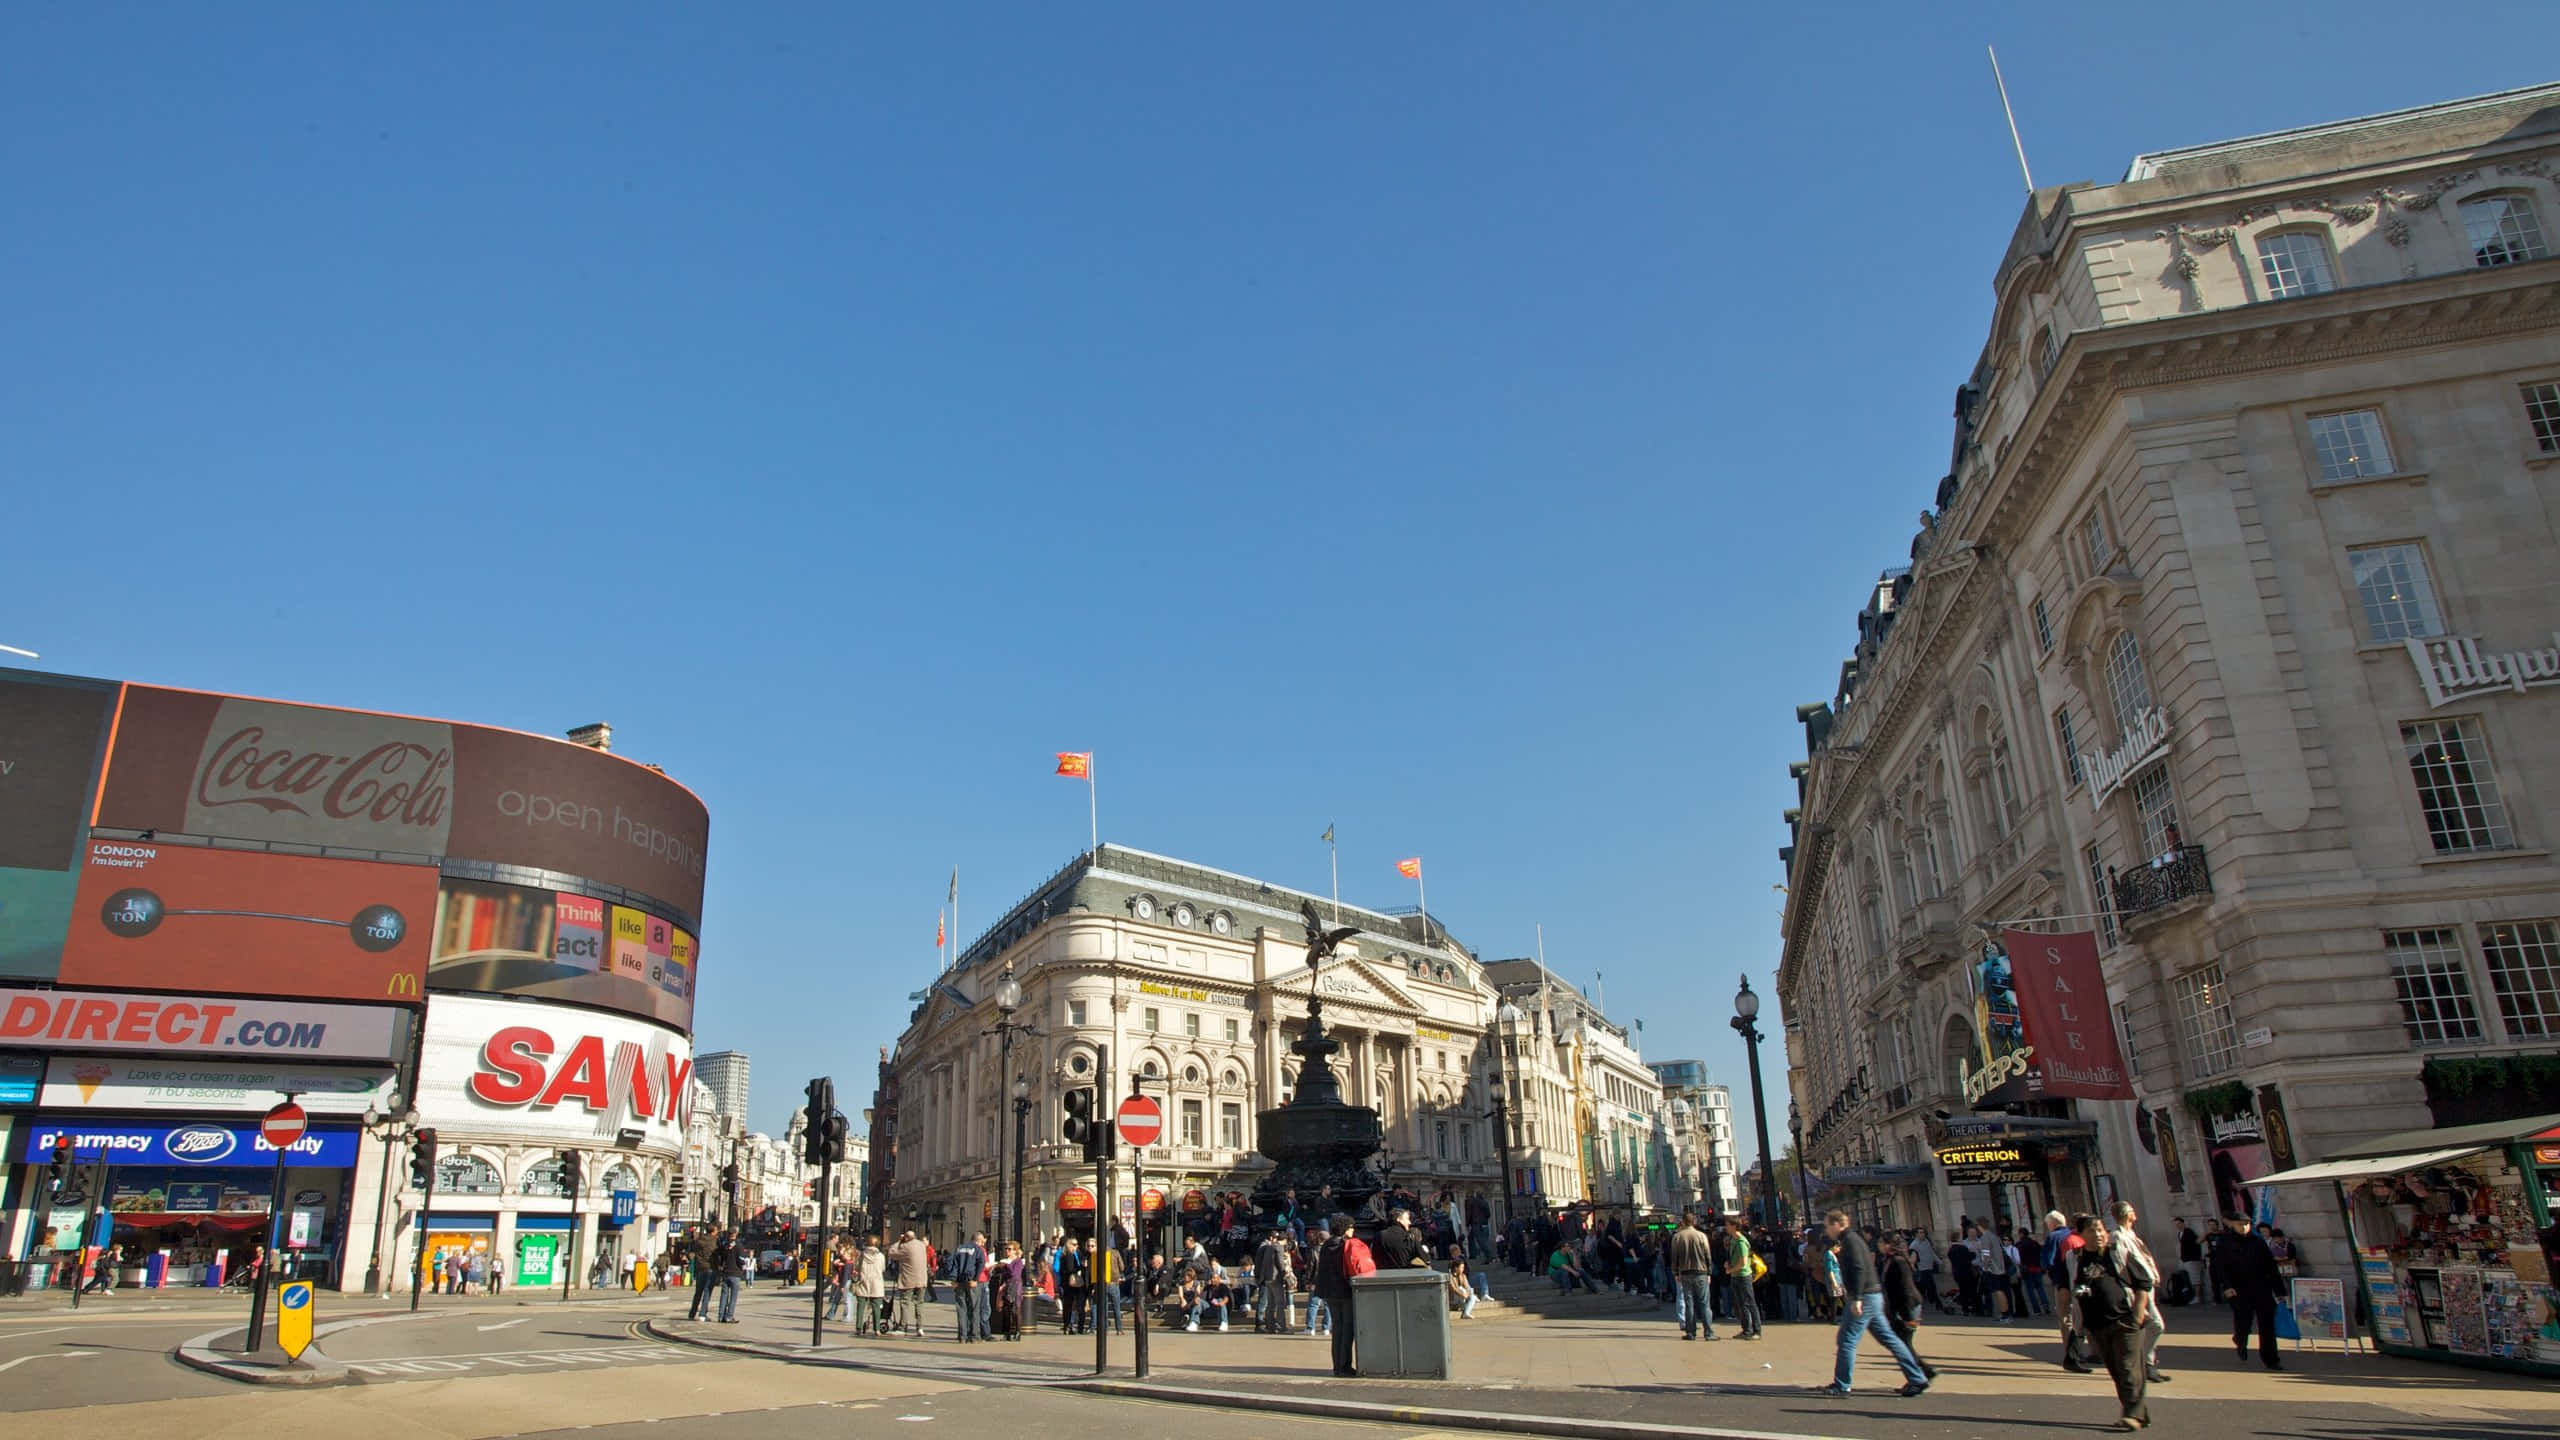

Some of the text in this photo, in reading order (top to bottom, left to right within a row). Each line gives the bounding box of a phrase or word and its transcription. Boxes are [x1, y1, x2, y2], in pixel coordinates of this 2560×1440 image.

[2404, 632, 2560, 709] Lillyw
[198, 726, 450, 826] Coca-Cola
[497, 791, 602, 830] open
[94, 845, 156, 859] LONDON
[112, 912, 147, 922] TON
[557, 903, 603, 923] Think
[619, 917, 641, 935] like
[654, 925, 664, 943] a
[367, 926, 398, 939] TON
[556, 936, 598, 957] act
[621, 953, 642, 971] like
[652, 965, 662, 981] a
[128, 1070, 275, 1086] Love ice cream again
[166, 1086, 184, 1097] 60
[188, 1088, 247, 1099] seconds
[1951, 1124, 1991, 1137] THEATRE
[39, 1131, 152, 1152] parmacy
[173, 1131, 224, 1153] Boots
[1943, 1149, 2020, 1165] CRITERION
[1981, 1169, 2001, 1183] 39
[617, 1198, 633, 1216] GAP
[524, 1262, 548, 1272] 60%
